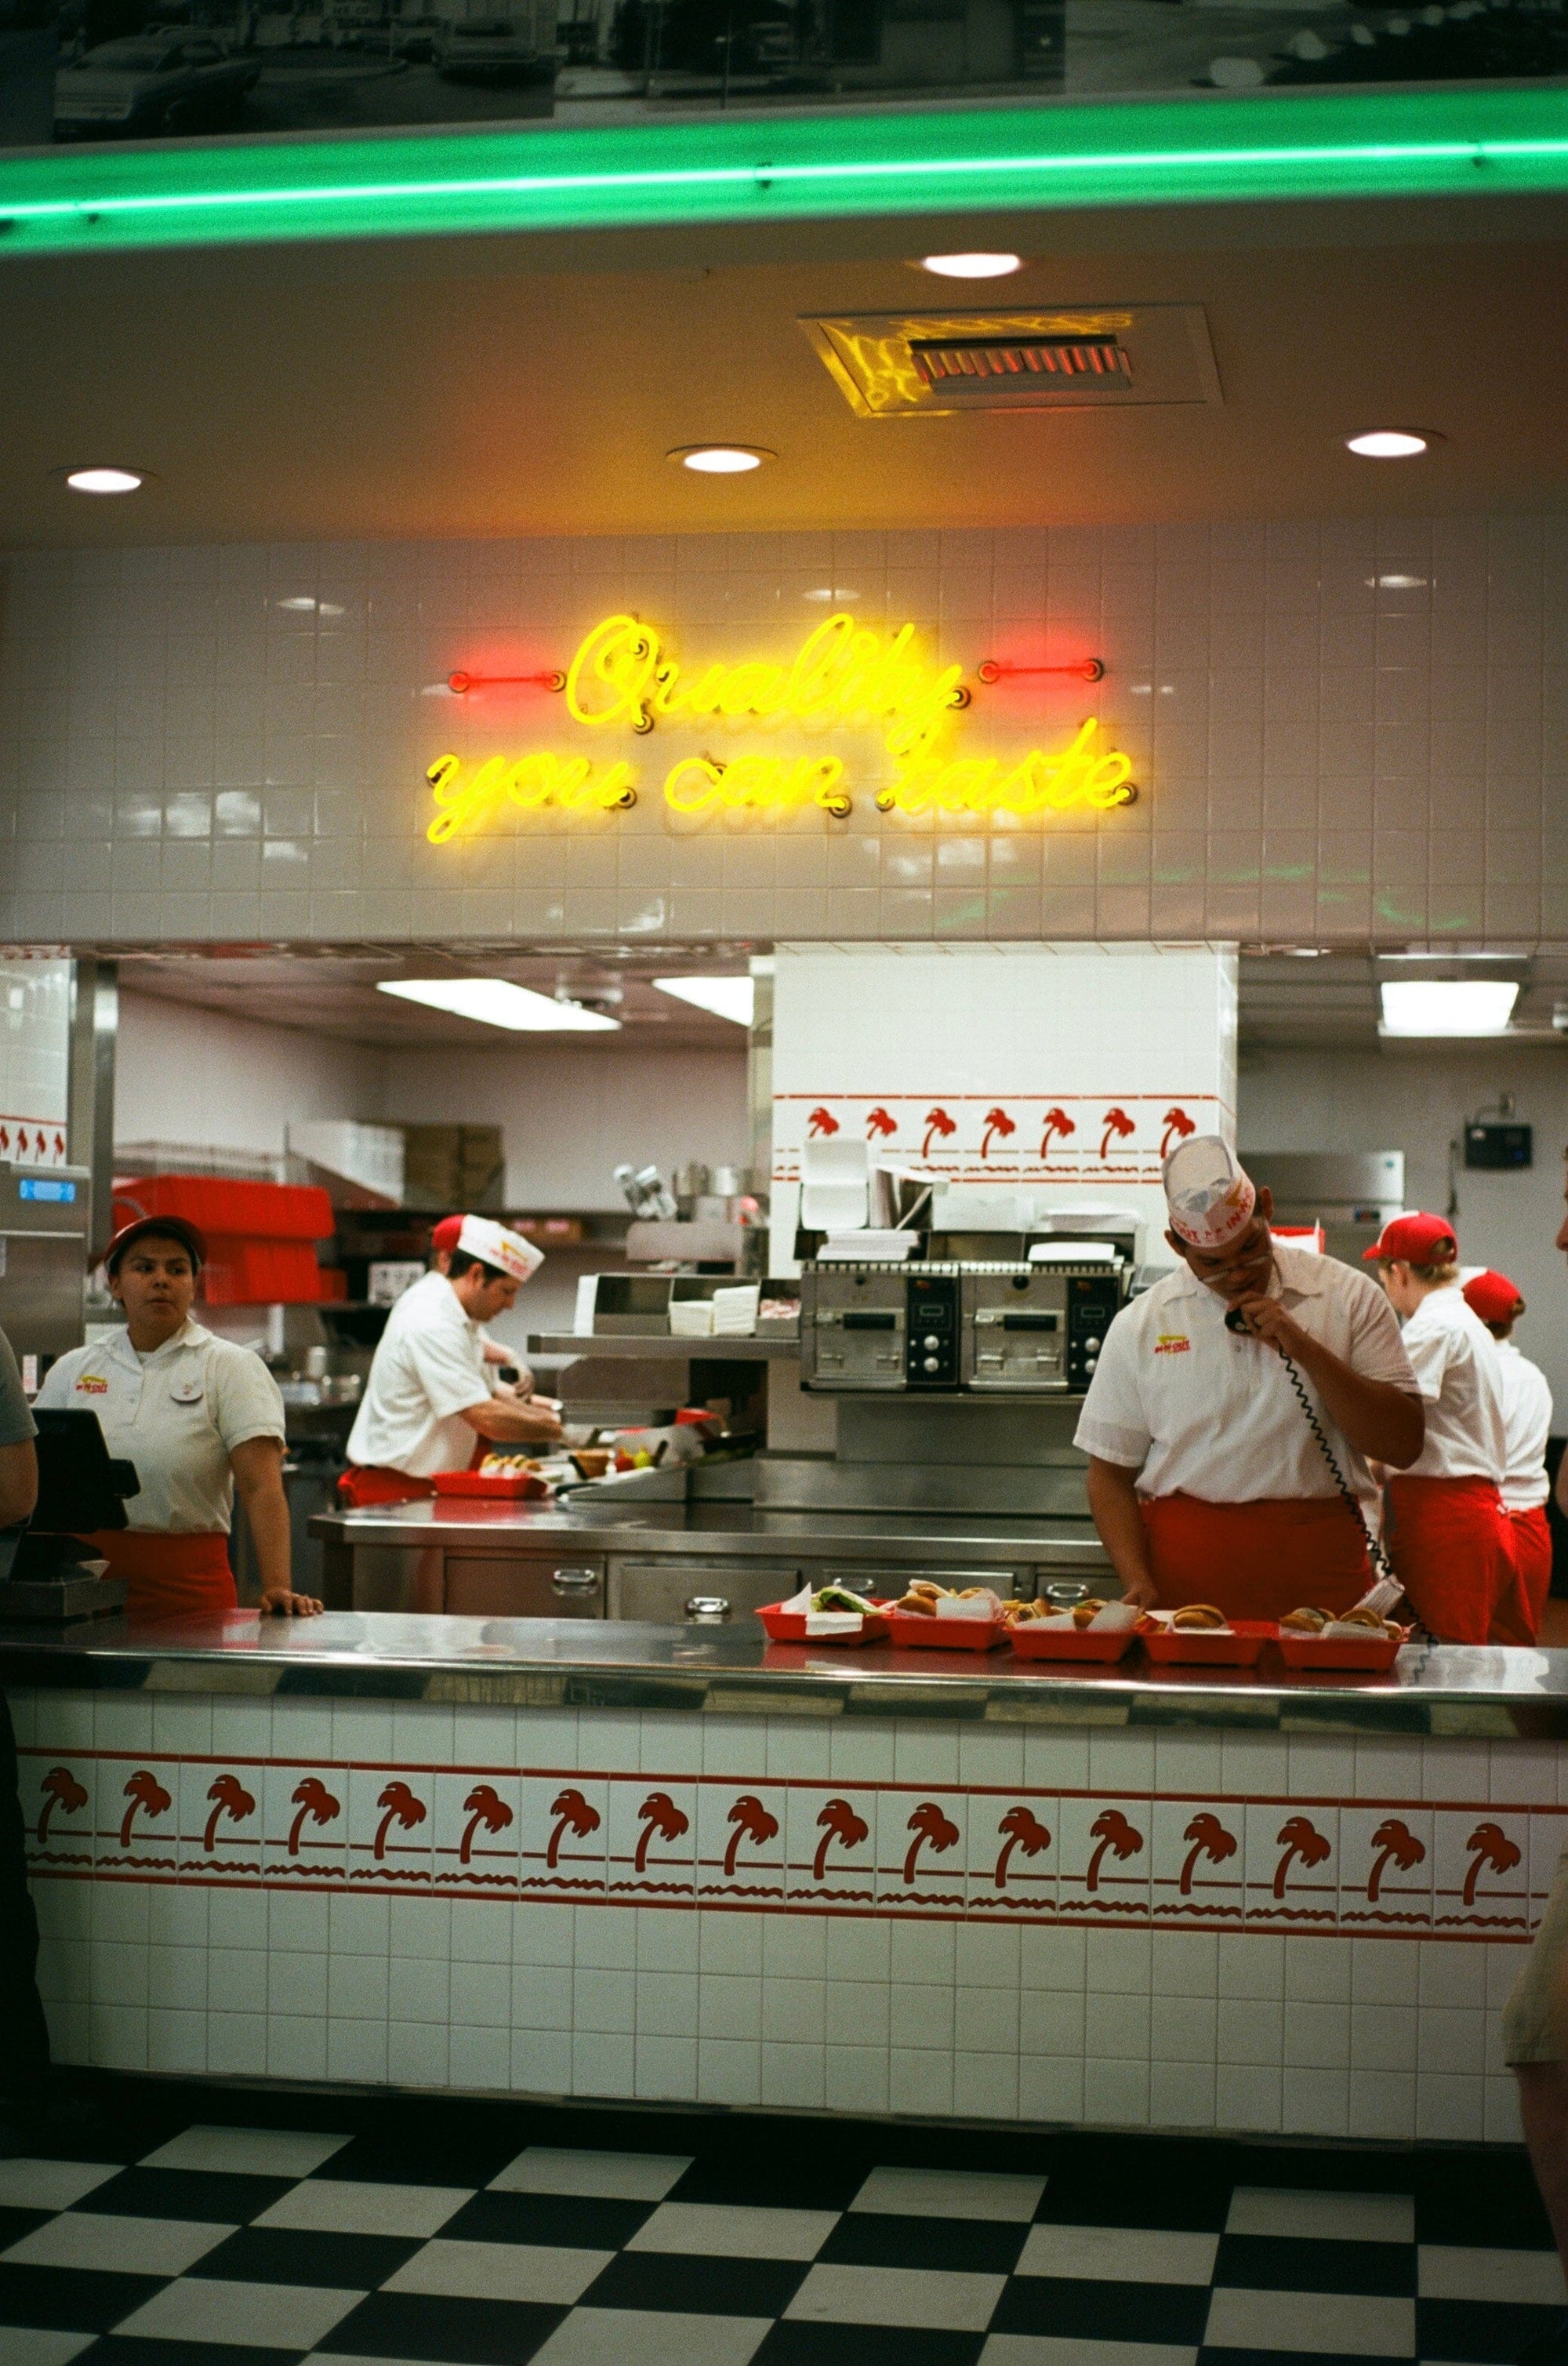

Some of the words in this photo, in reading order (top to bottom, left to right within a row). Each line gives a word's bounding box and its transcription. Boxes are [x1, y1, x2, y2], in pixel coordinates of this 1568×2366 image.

[566, 614, 965, 754] Quality
[426, 752, 630, 844] you
[664, 755, 845, 812] can
[877, 717, 1132, 812] taste
